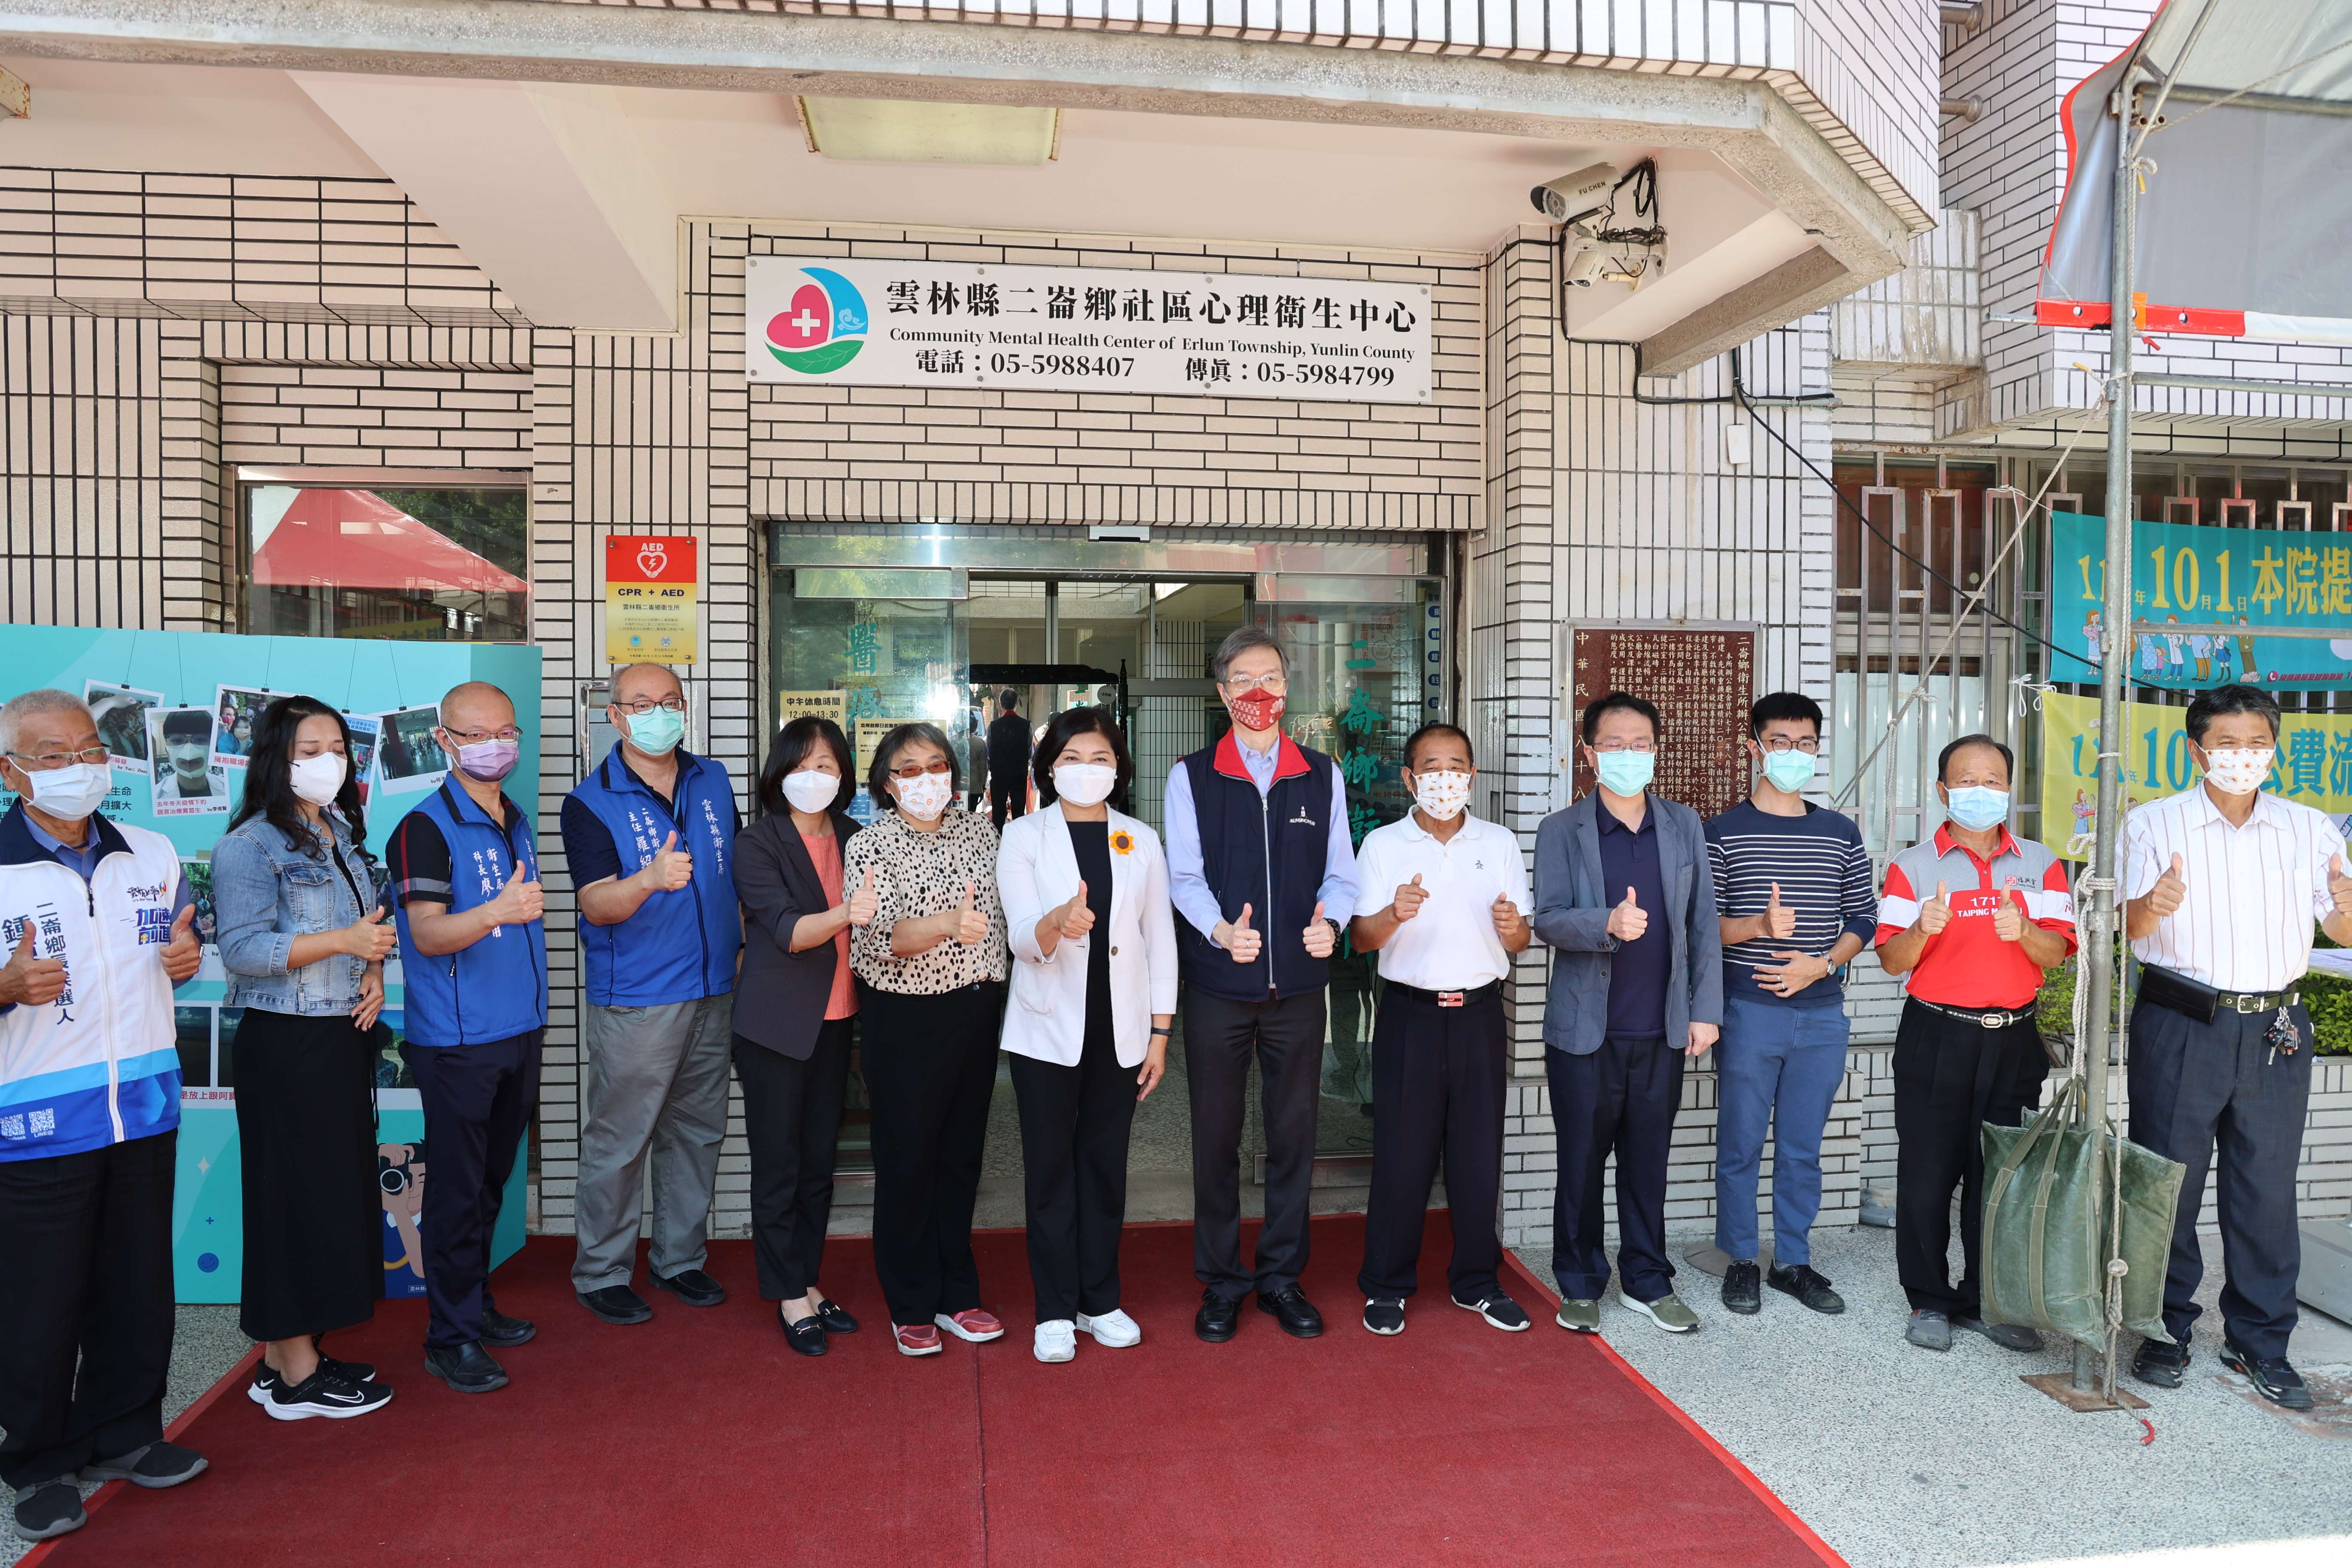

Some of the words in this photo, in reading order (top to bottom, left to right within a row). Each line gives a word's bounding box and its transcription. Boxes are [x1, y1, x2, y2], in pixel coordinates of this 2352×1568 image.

[1588, 181, 1606, 192] CHEN
[886, 279, 1416, 332] 雲林縣二崙鄉社區心理衛生中心
[889, 327, 984, 346] Community
[988, 331, 1043, 345] Mental
[1047, 333, 1099, 347] Health
[1103, 335, 1155, 349] Center
[1159, 336, 1176, 350] of
[1182, 338, 1224, 352] Erlun
[1228, 340, 1306, 358] Township,
[1311, 343, 1359, 357] Yunlin
[1363, 345, 1415, 363] County
[915, 349, 1135, 377] 電話：05-5988407
[641, 543, 664, 551] AED
[787, 697, 840, 706] 中午休息時間
[789, 710, 839, 719] 12:00-13:30
[642, 808, 661, 854] 二崙鄉衛
[701, 799, 724, 876] 雲林縣衛生局
[1957, 908, 1989, 917] TAIPING
